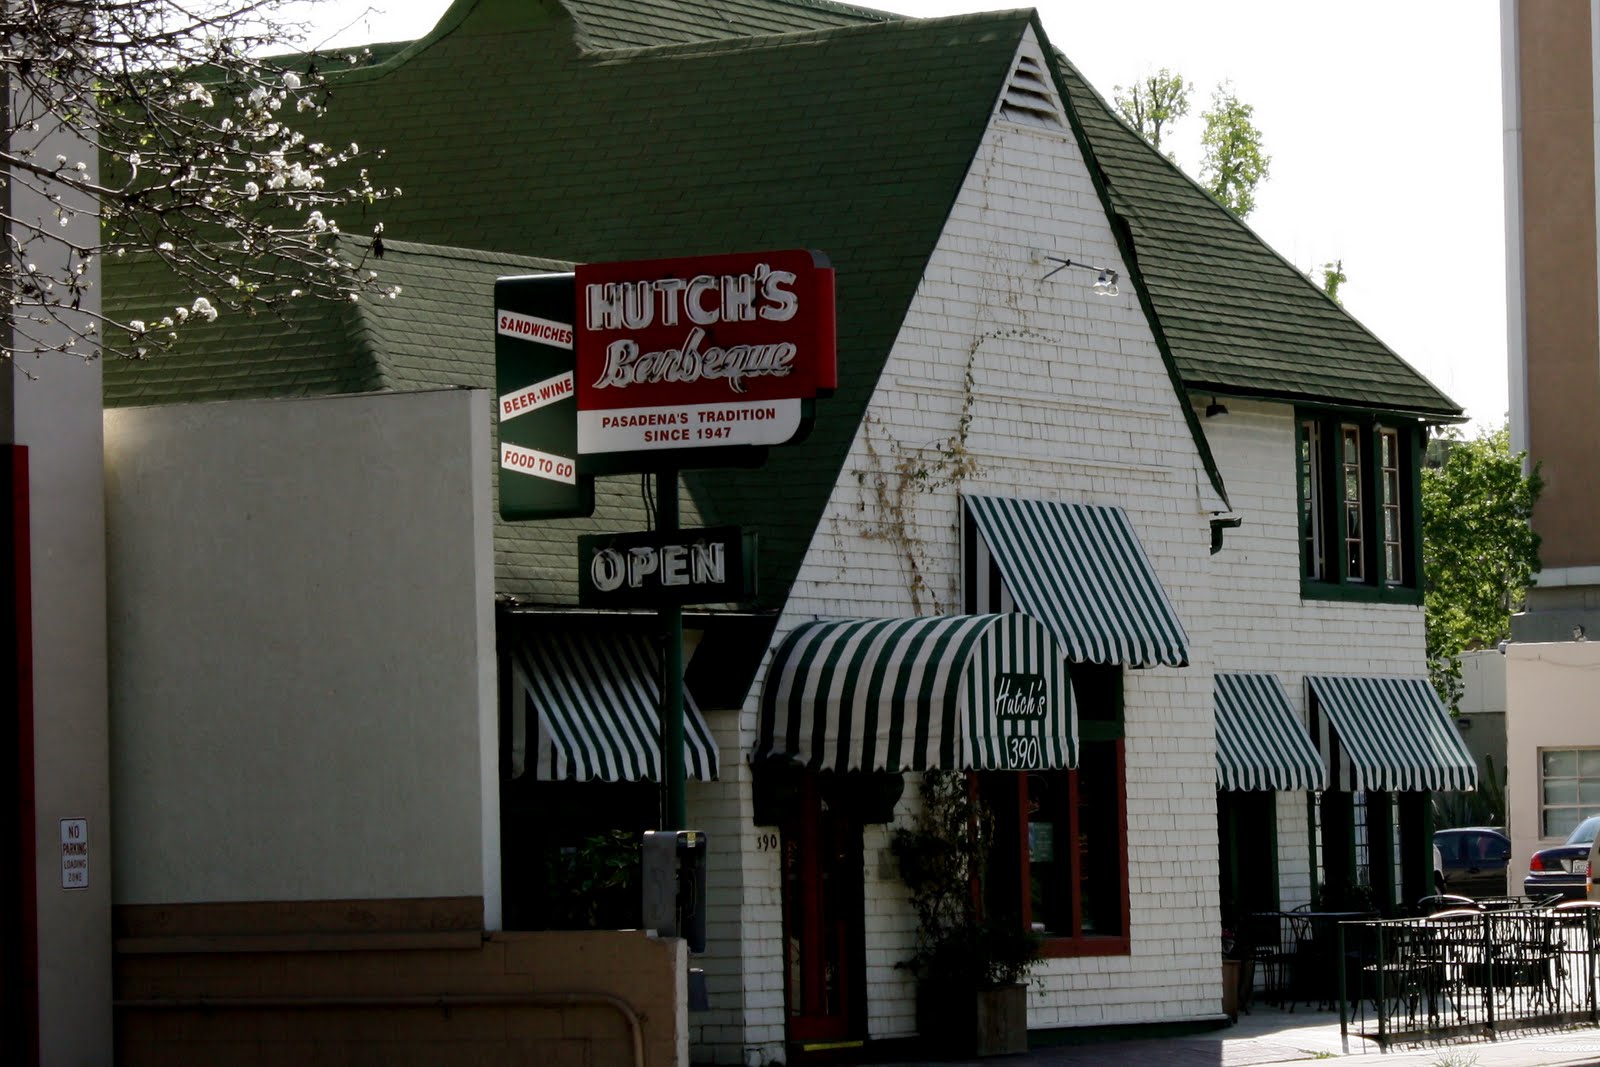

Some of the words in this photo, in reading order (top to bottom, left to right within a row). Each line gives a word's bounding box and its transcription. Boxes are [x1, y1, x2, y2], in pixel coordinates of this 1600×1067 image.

[586, 263, 798, 330] HUTCH'S
[500, 316, 573, 344] SANDWICHES
[592, 327, 797, 394] Barbeque
[602, 412, 689, 428] PASADENA'S
[698, 408, 776, 423] TRADITION
[644, 430, 690, 442] SINCE
[697, 427, 732, 440] 1947
[504, 451, 535, 469] FOOD
[539, 458, 553, 473] TO
[556, 463, 573, 478] GO
[591, 543, 725, 592] OPEN
[995, 677, 1045, 716] Hutch's
[1010, 737, 1037, 768] 390
[68, 825, 80, 839] NO
[756, 834, 777, 852] 390
[63, 842, 87, 856] PARKING
[64, 859, 86, 869] LOADING
[68, 872, 82, 882] ZONE
